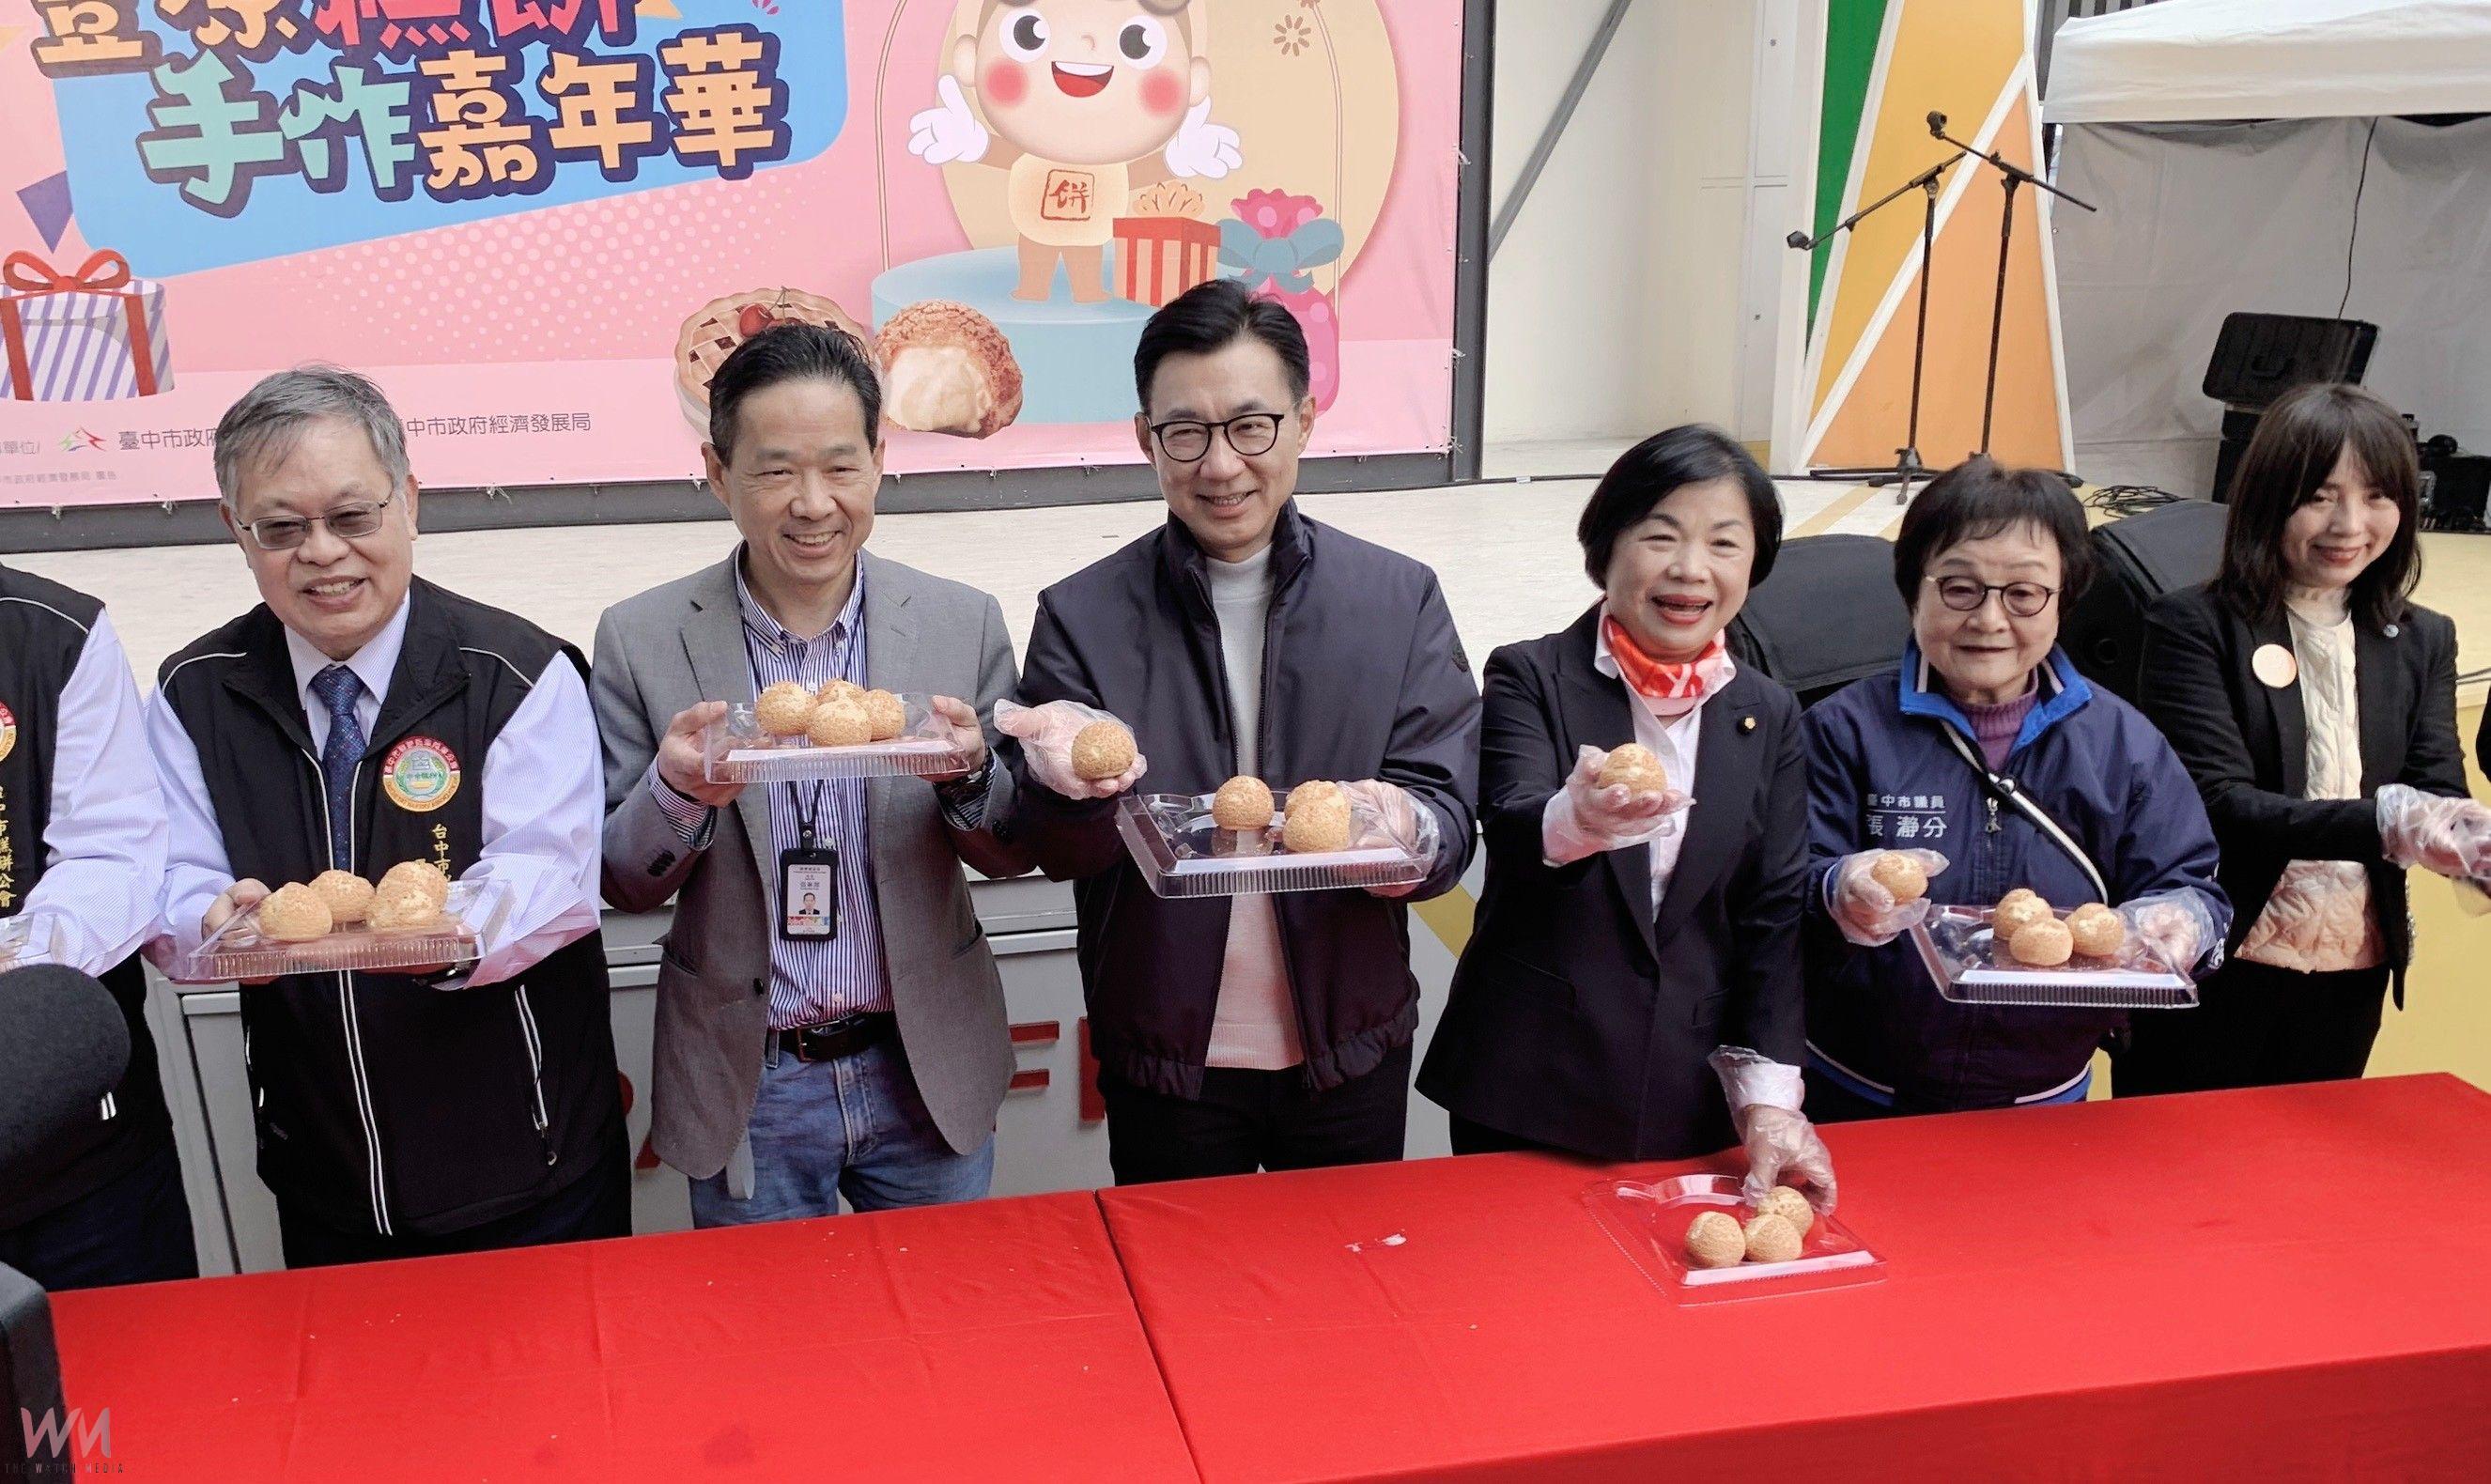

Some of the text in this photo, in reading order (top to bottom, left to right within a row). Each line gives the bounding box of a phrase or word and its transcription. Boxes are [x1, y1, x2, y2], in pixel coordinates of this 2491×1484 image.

[140, 31, 778, 206] 手作嘉年華
[399, 412, 592, 437] 中市政府經濟發展局
[432, 823, 452, 882] 台中市
